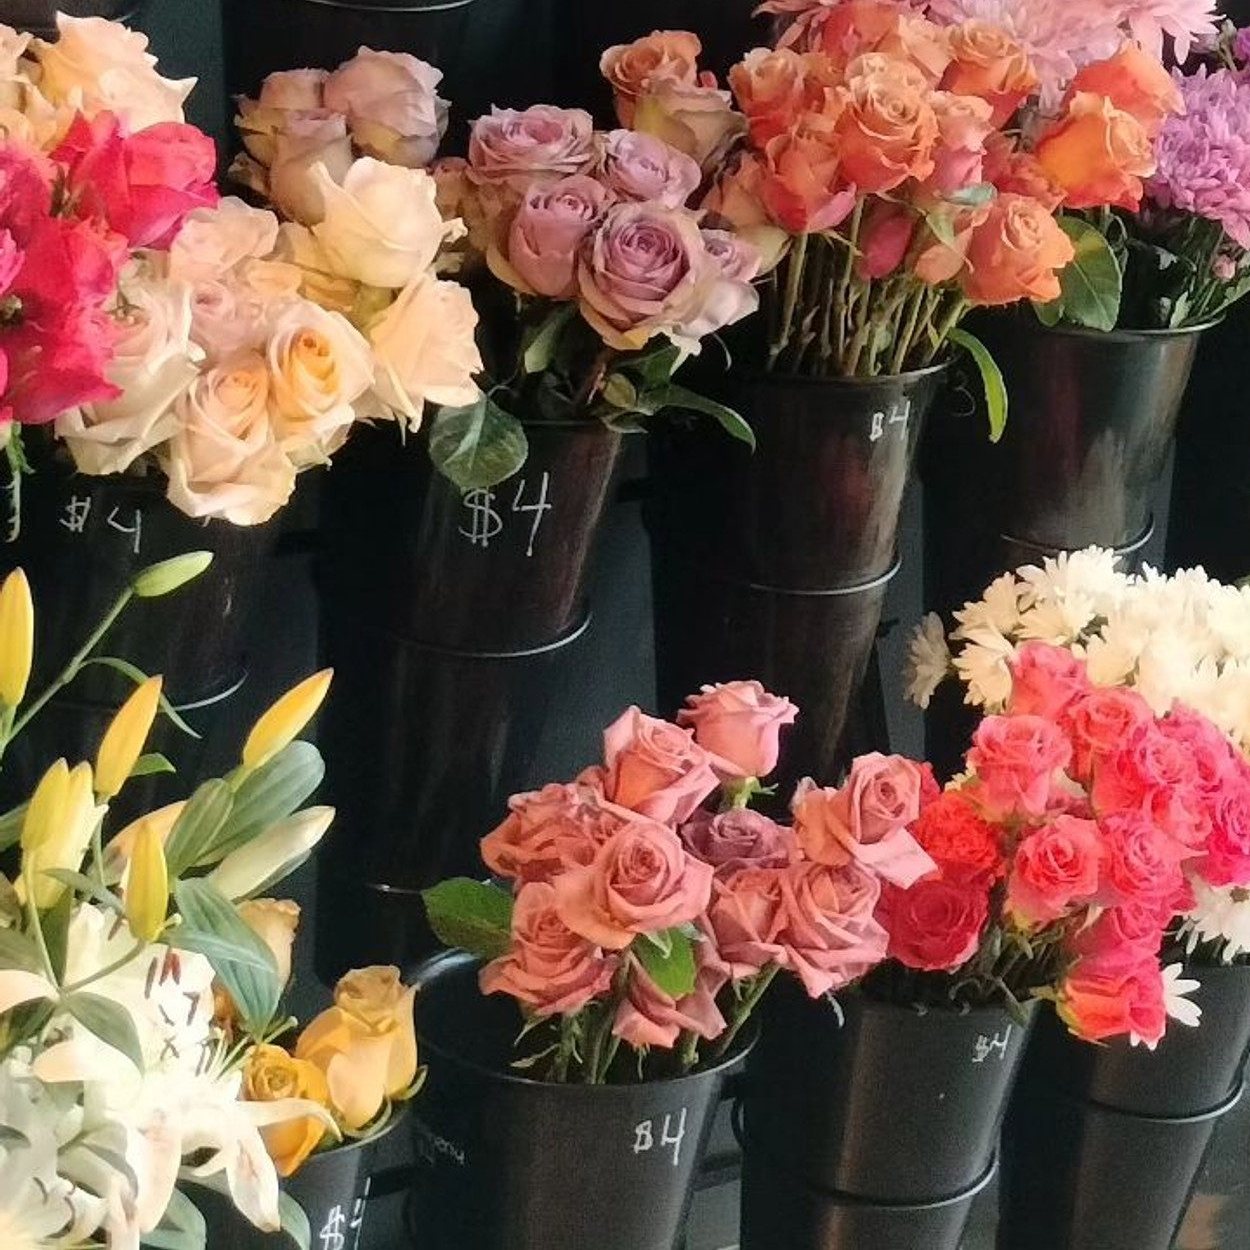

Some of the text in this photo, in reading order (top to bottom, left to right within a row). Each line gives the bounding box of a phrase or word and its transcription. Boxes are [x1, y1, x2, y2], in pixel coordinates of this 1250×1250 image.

[59, 496, 142, 553] $4
[458, 471, 553, 557] $4
[634, 1106, 687, 1165] $4
